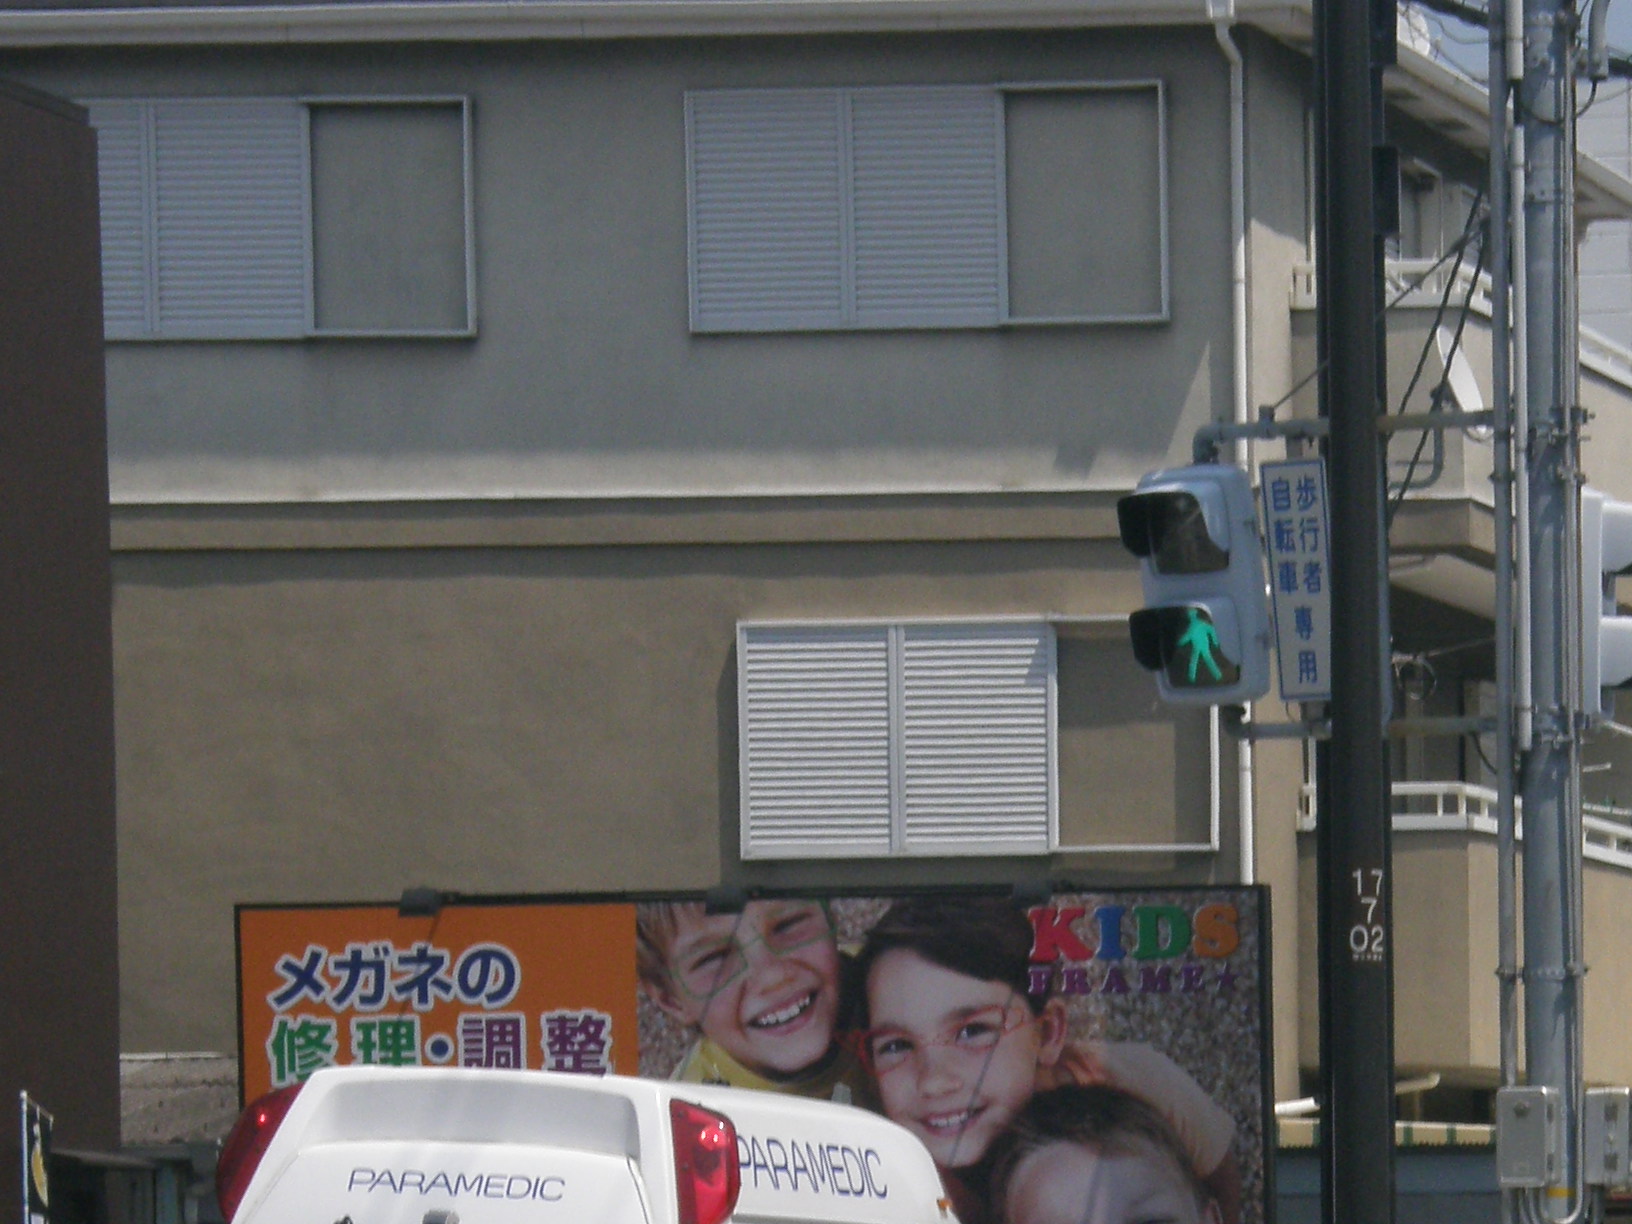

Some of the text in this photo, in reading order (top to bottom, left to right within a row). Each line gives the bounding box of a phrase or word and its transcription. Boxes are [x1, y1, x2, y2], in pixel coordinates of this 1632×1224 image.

[1271, 477, 1298, 594] 自転車
[1296, 475, 1322, 594] 歩行者
[1293, 605, 1318, 684] 専用
[1352, 867, 1383, 896] 17
[1361, 896, 1377, 924] 7
[1027, 903, 1240, 962] KIDS
[1350, 924, 1384, 953] 02
[268, 942, 519, 1010] メガネの
[1028, 964, 1205, 996] FRAME
[266, 1010, 612, 1086] 修理・調整
[347, 1167, 567, 1201] PARAMEDIC
[736, 1133, 888, 1199] PARAMEDIC
